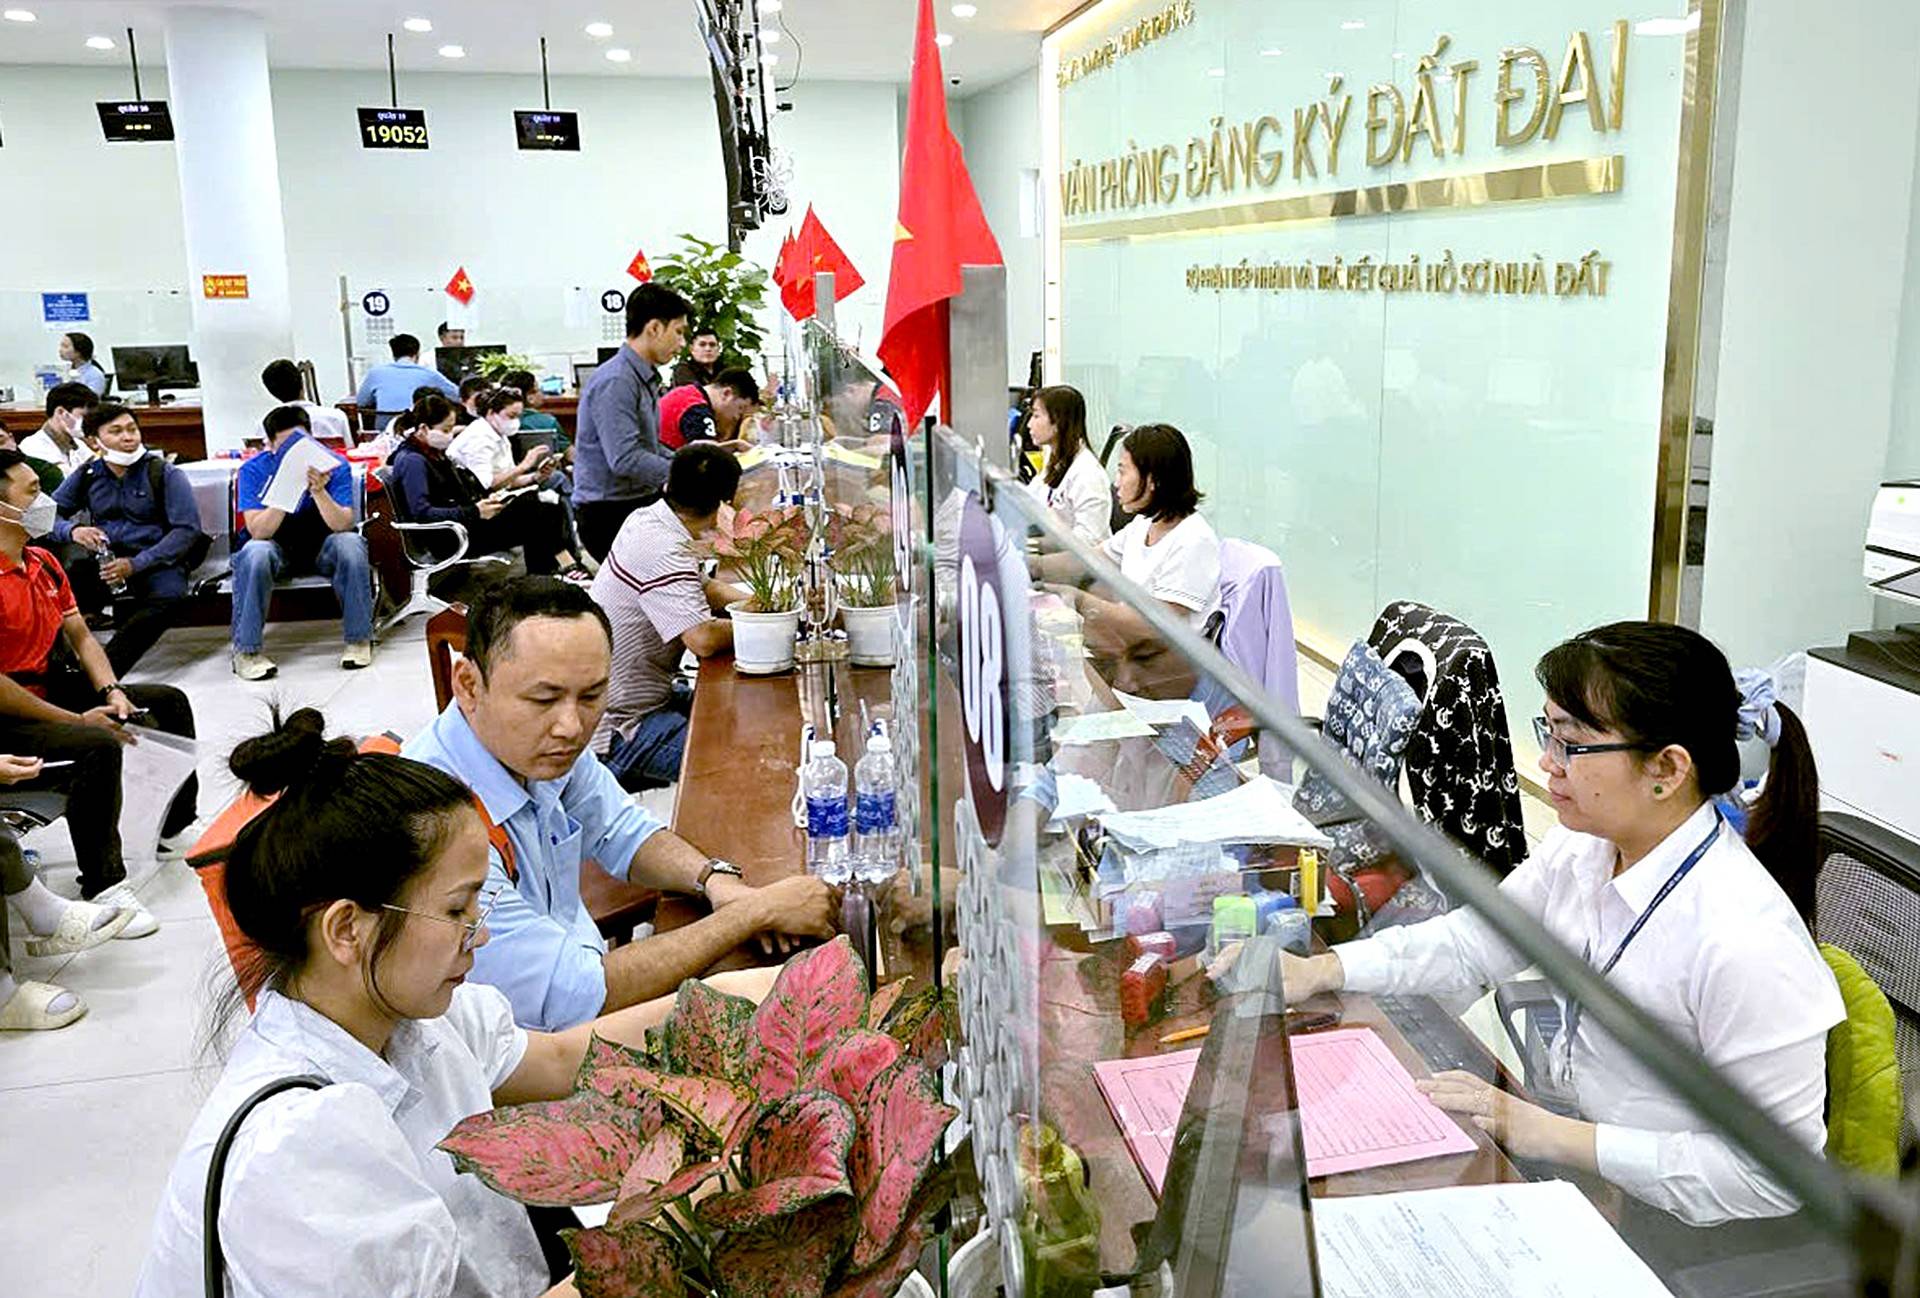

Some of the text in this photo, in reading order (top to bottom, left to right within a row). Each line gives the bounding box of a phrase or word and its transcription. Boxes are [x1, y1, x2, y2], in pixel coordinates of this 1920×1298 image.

[1100, 139, 1179, 211] PHÒNG
[1186, 116, 1283, 199] ĐĂNG
[1293, 76, 1352, 180] KÝ
[1366, 34, 1479, 168] ĐẤT
[1494, 19, 1629, 148] ĐAI
[366, 124, 427, 143] 19052
[1494, 252, 1548, 295] NHÀ
[1554, 250, 1613, 297] ĐẤT
[366, 295, 386, 312] 19
[603, 293, 623, 310] 18
[961, 553, 1005, 793] 08
